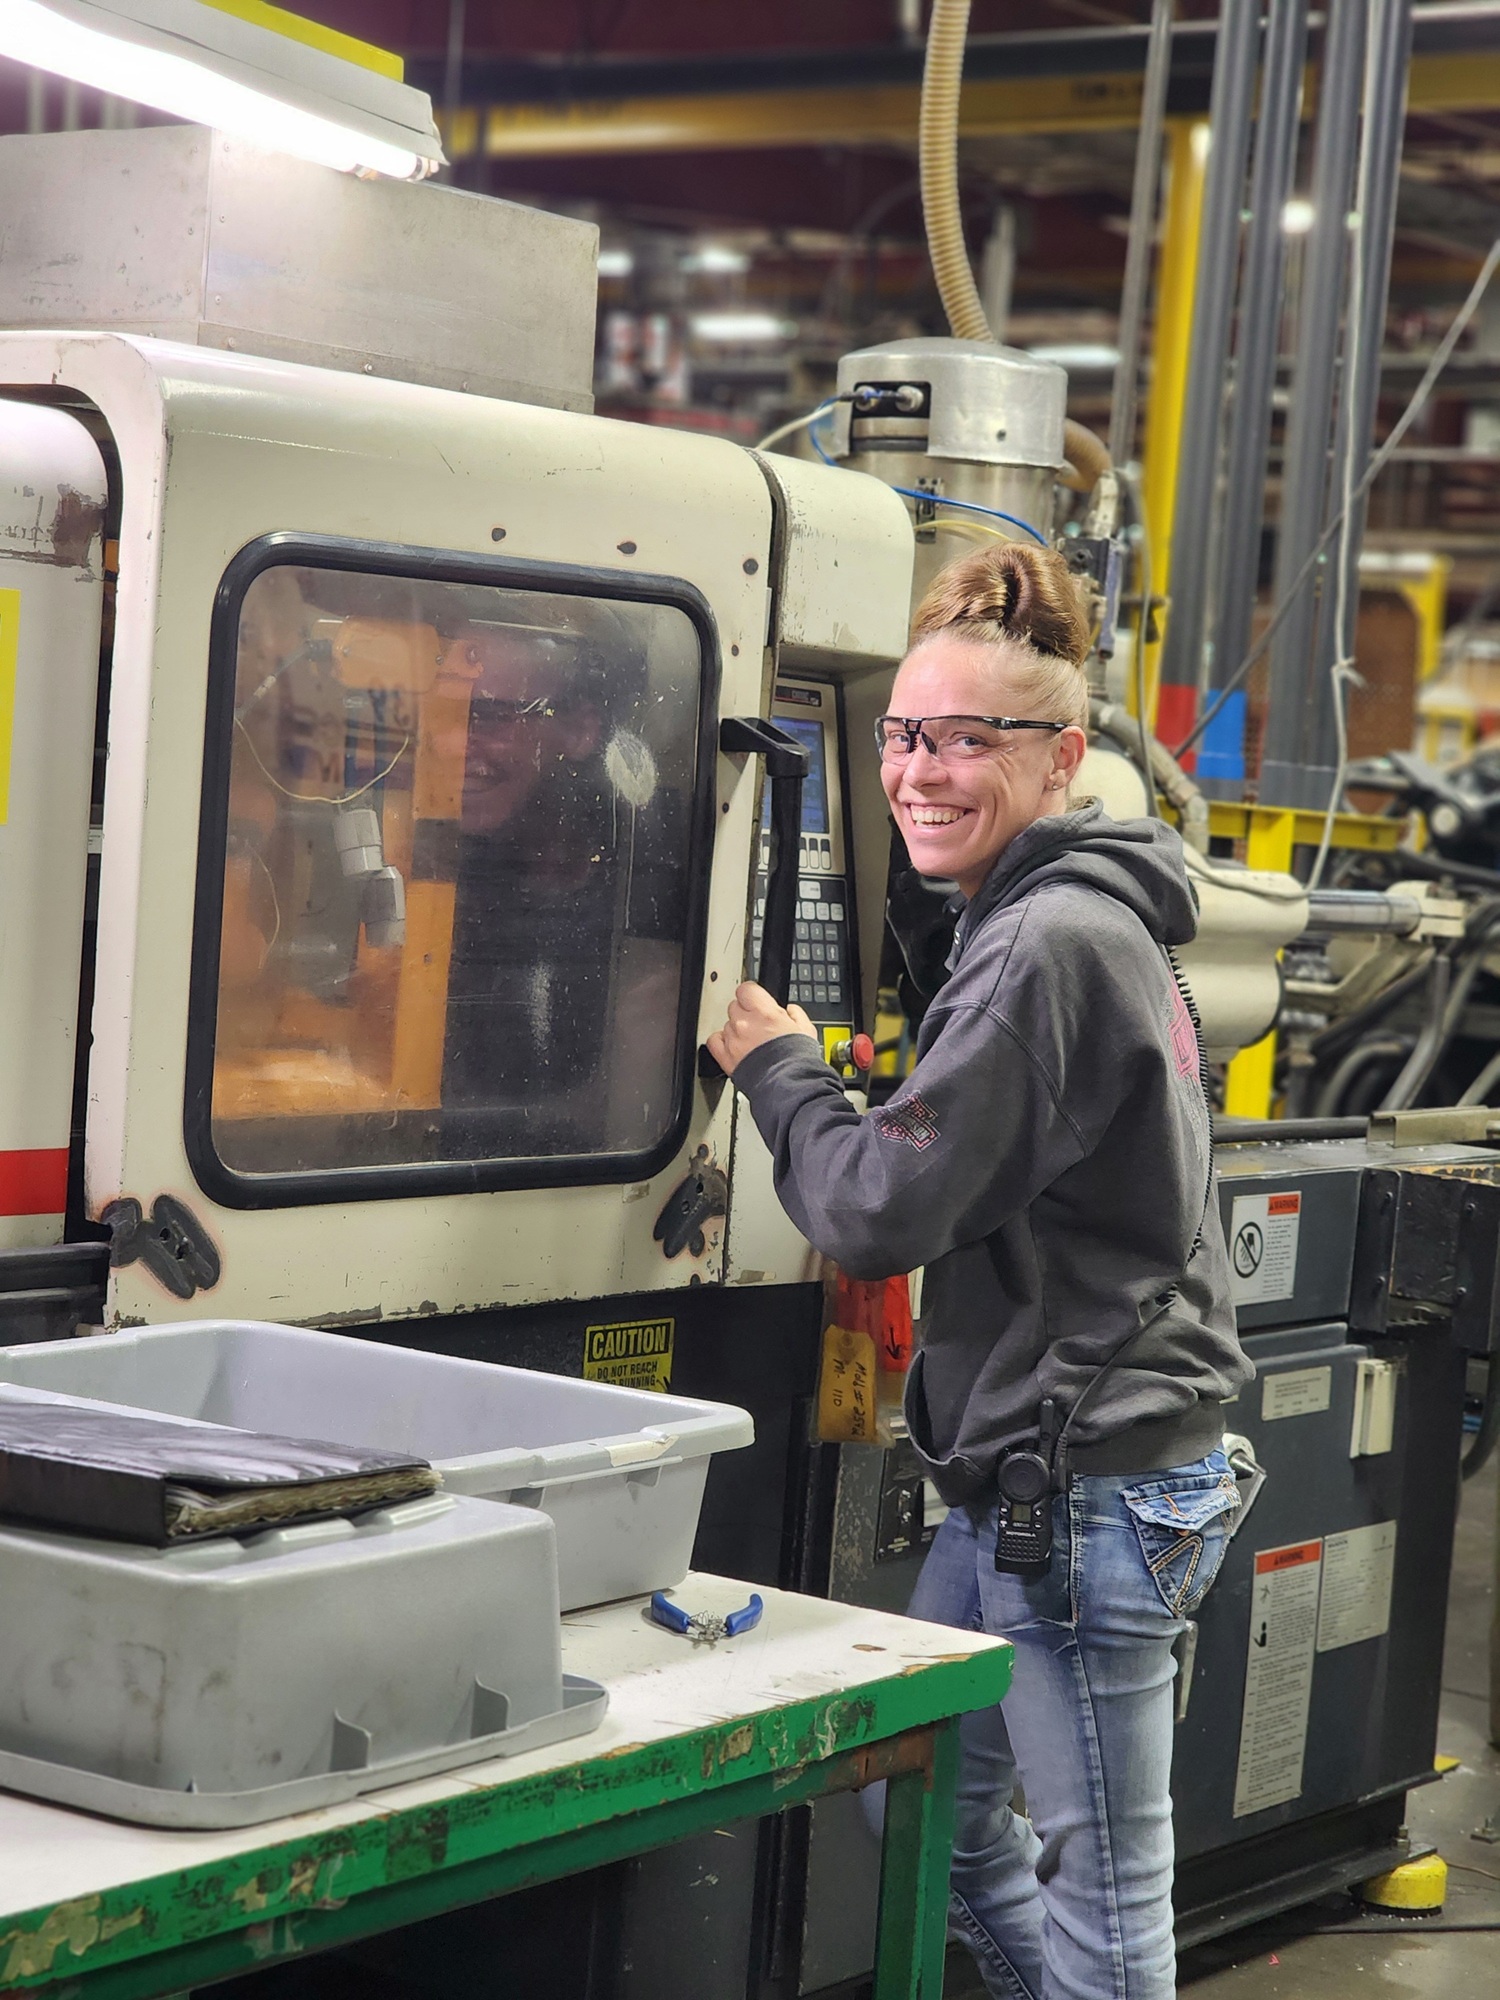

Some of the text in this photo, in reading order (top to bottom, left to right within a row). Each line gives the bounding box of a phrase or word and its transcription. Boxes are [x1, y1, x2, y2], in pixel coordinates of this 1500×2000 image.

[592, 1325, 666, 1360] CAUTION
[597, 1360, 658, 1379] DO NOT REACH
